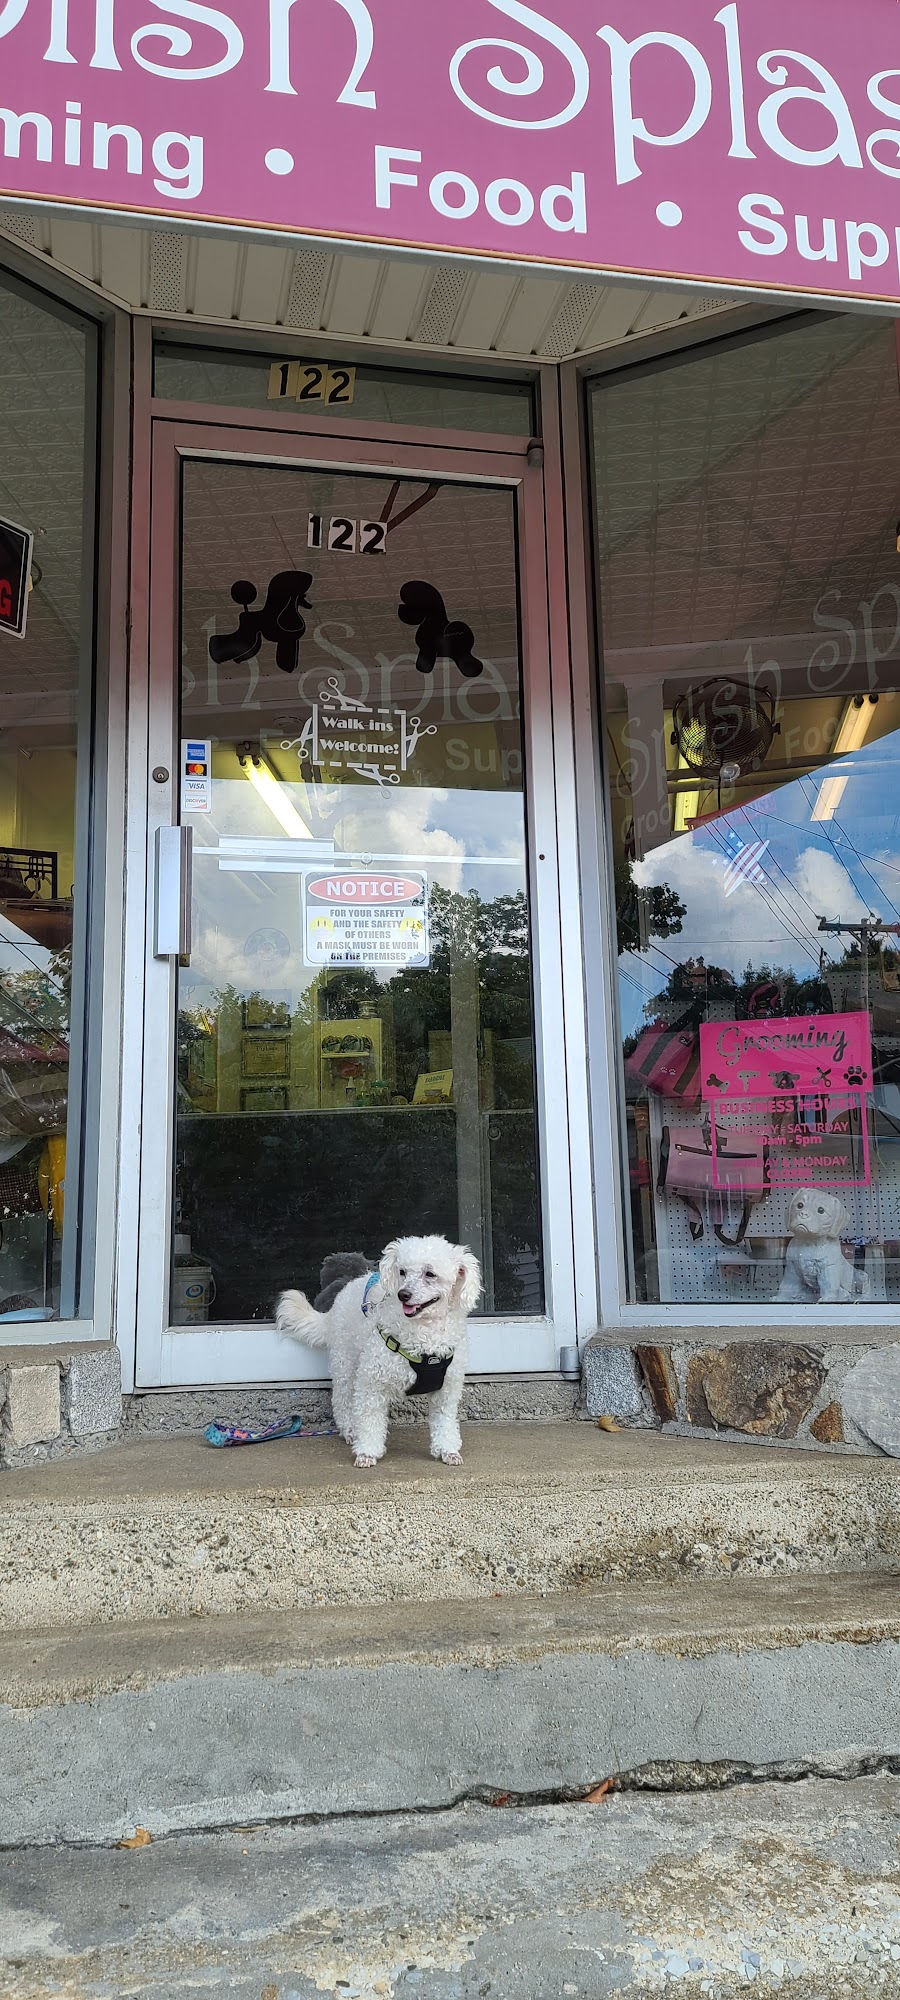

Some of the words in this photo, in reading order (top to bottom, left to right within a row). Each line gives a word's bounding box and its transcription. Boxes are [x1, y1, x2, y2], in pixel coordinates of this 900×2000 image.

[374, 145, 587, 234] Food
[738, 193, 900, 282] Sup
[279, 364, 350, 404] 122
[309, 515, 385, 554] 122
[322, 716, 394, 732] Walk-ins
[319, 738, 400, 755] Welcome!
[188, 782, 205, 790] VISA
[327, 881, 405, 896] NOTICE
[330, 909, 347, 917] FOR
[348, 909, 371, 917] YOUR
[374, 909, 405, 918] SAFETY
[333, 920, 352, 928] AND
[354, 920, 369, 928] THE
[371, 920, 402, 929] SAFETY
[345, 930, 355, 939] OF
[357, 930, 391, 939] OTHERS
[316, 941, 323, 950] A
[324, 941, 351, 950] MASK
[352, 941, 377, 950] MUST
[380, 941, 390, 950] BE
[392, 941, 419, 950] WORN
[362, 952, 406, 960] PREMISES
[716, 1025, 849, 1066] Grooming
[719, 1100, 795, 1115] BUSINESS
[799, 1097, 857, 1112] HOURS
[787, 1121, 849, 1135] SATURDAY
[795, 1135, 822, 1148] 5pm
[792, 1156, 848, 1168] MONDAY
